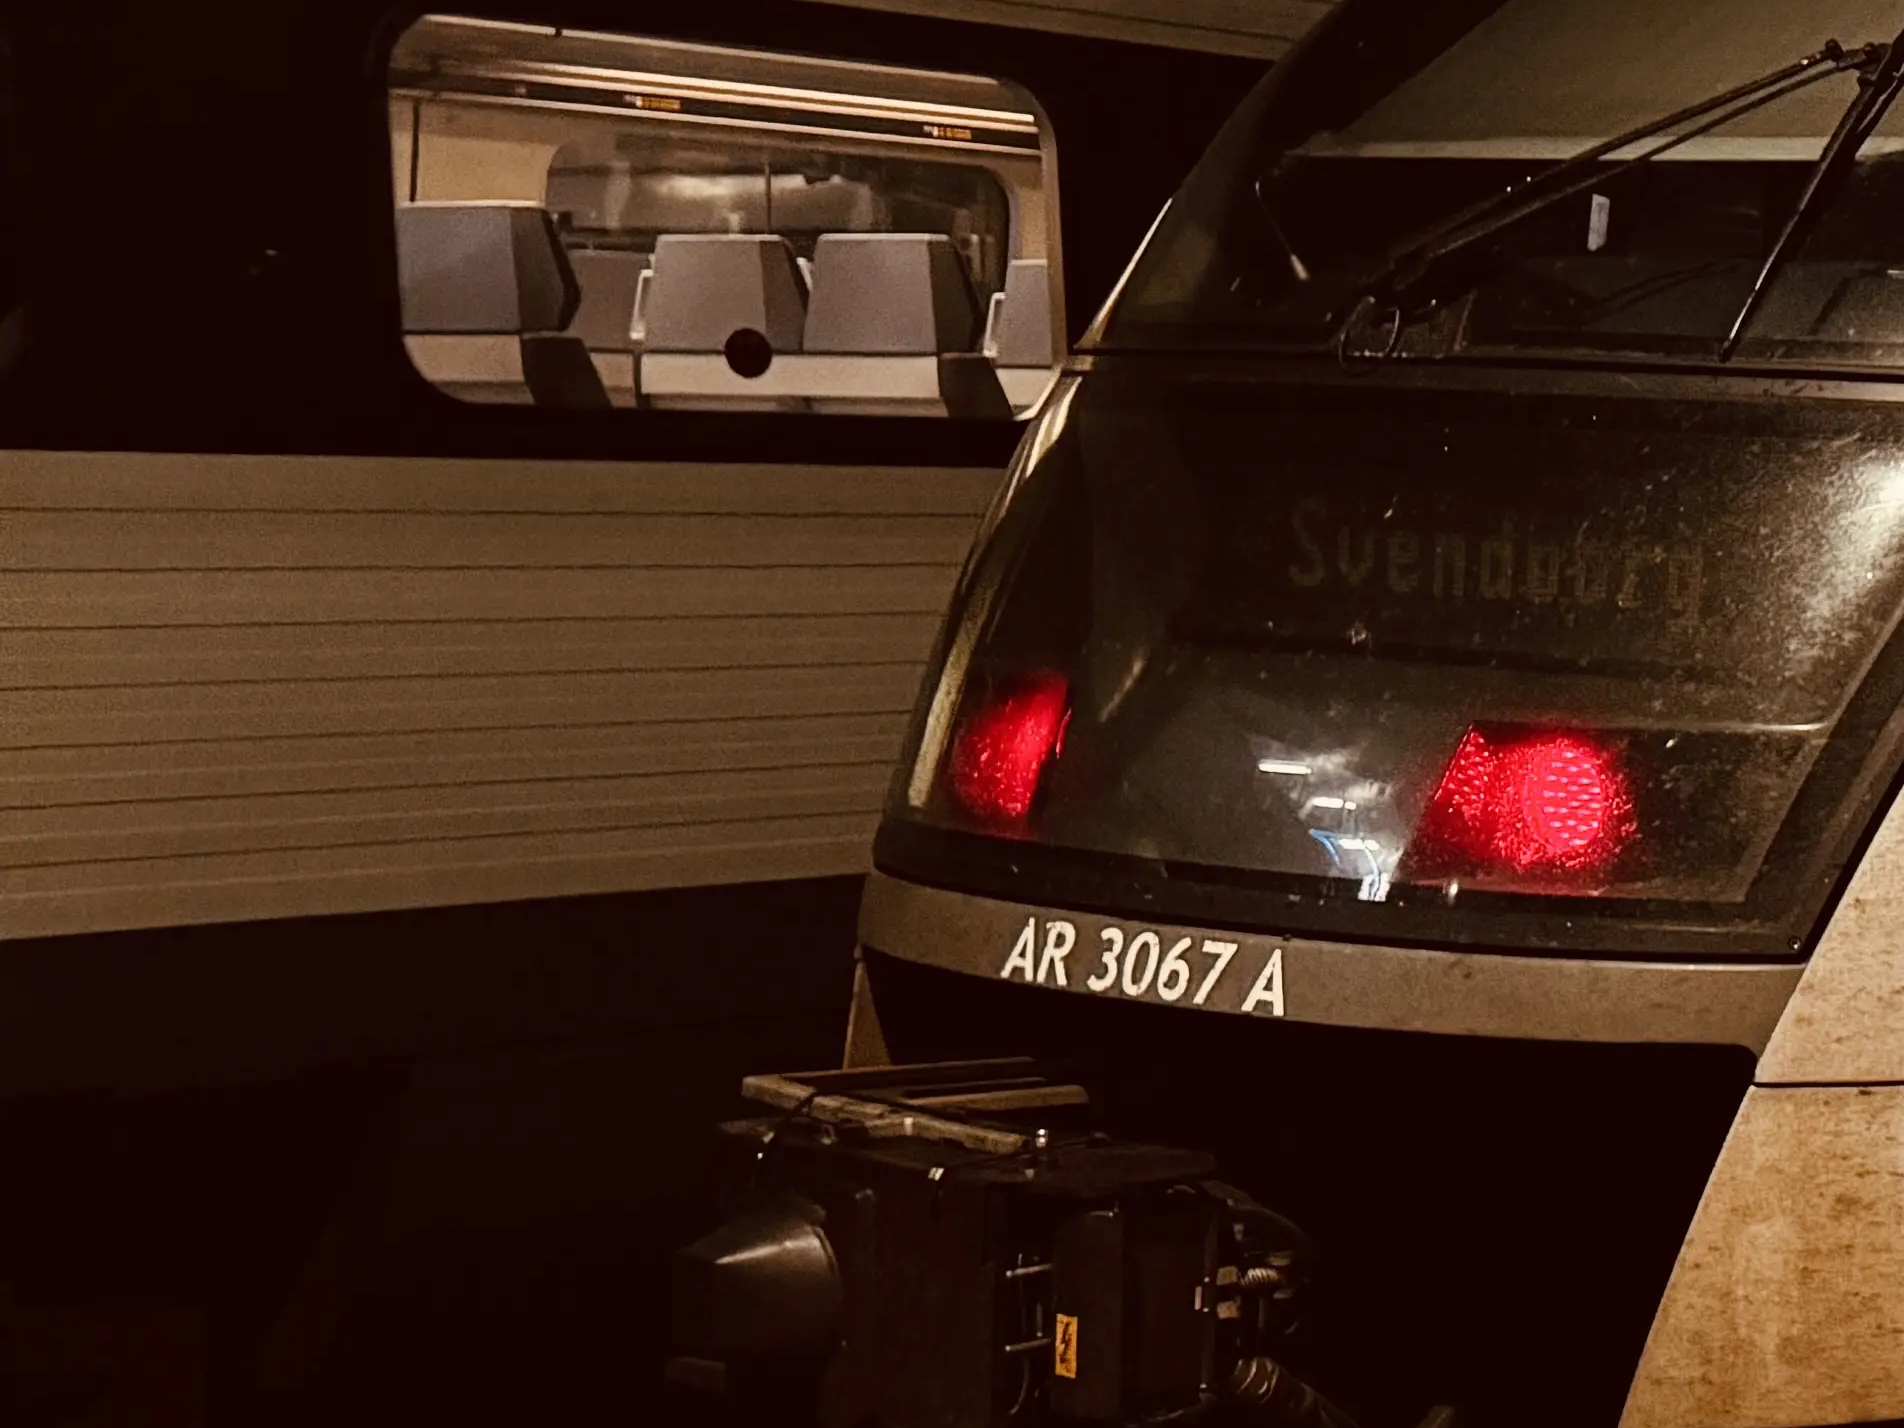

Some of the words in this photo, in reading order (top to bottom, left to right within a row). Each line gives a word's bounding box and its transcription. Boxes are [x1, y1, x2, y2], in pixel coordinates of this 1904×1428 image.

[1000, 917, 1076, 987] AR
[1086, 927, 1239, 1004] 3067
[1240, 948, 1285, 1017] A
